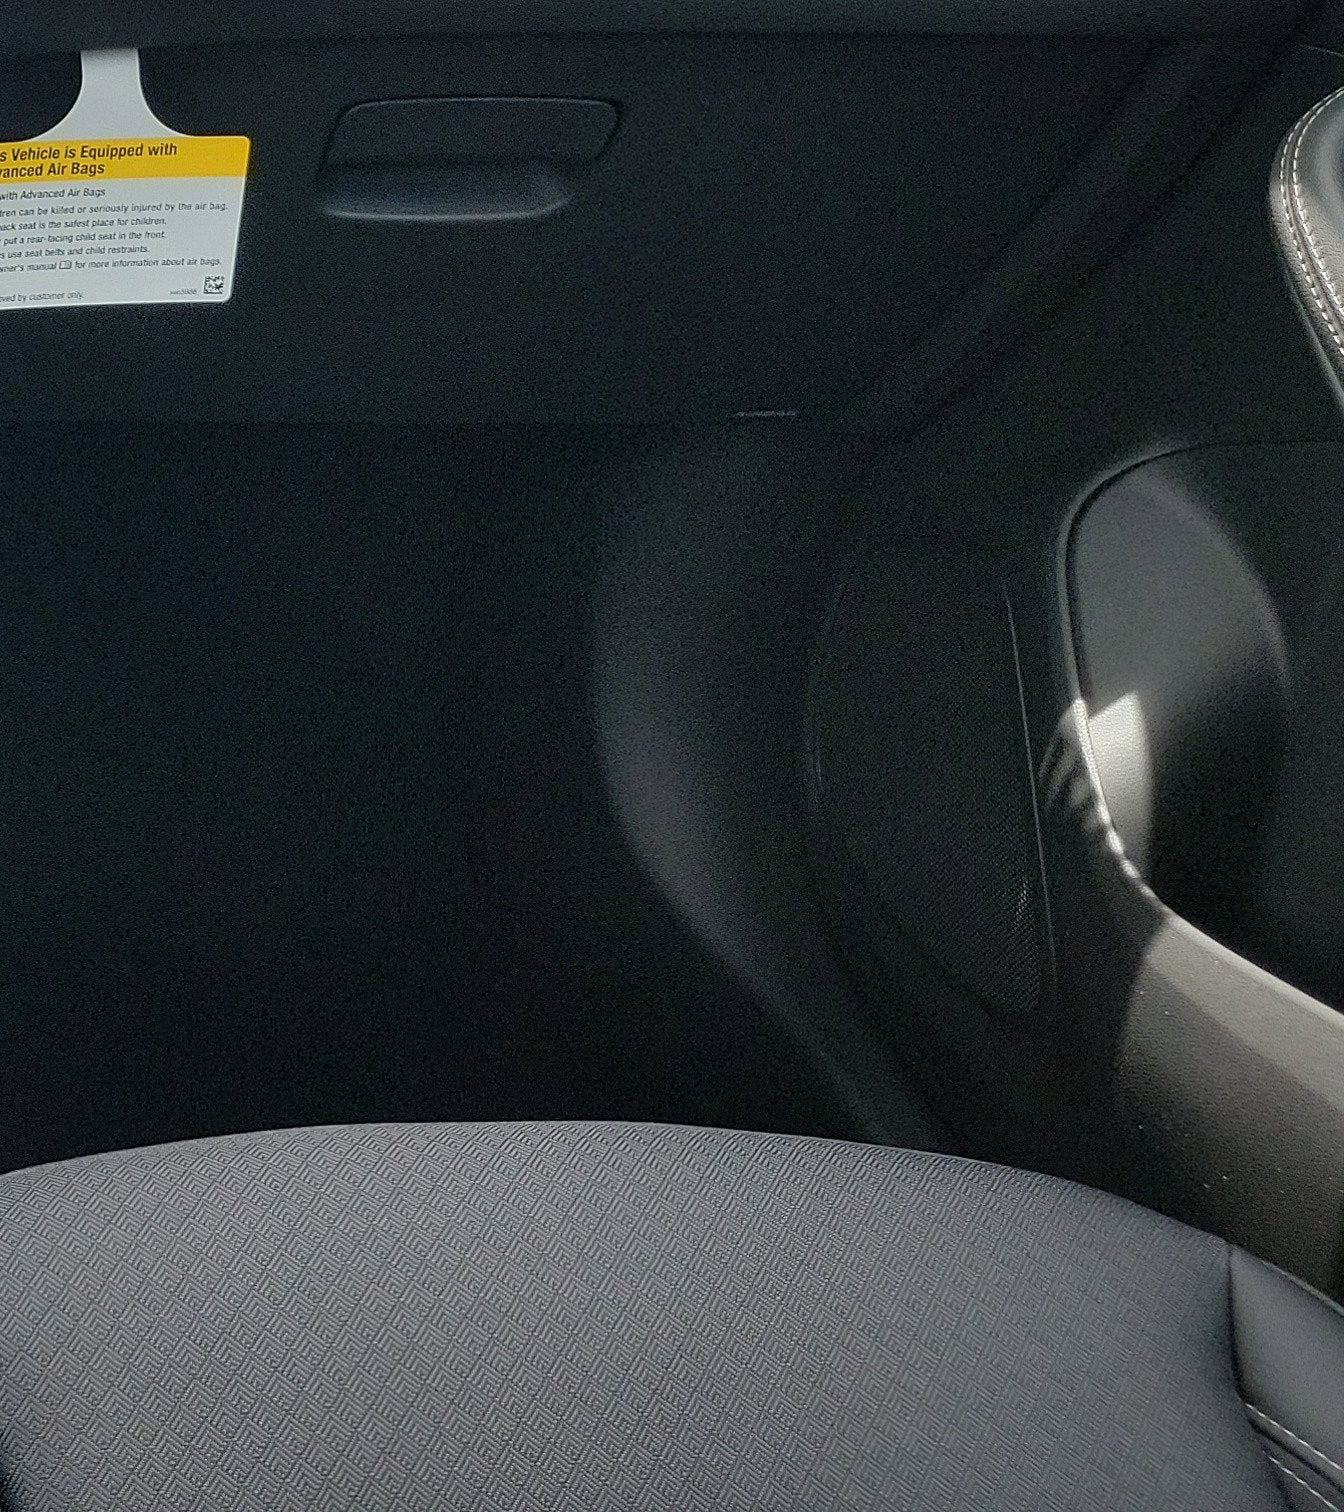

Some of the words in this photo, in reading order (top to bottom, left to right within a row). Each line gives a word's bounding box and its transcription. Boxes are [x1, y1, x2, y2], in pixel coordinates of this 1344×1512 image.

[12, 147, 60, 162] Vehicle
[64, 146, 76, 159] is
[80, 143, 144, 160] Equipped
[148, 143, 178, 157] with
[47, 163, 68, 176] Air
[71, 162, 105, 177] Bags
[0, 191, 18, 201] with
[20, 189, 65, 200] Advanced
[67, 189, 80, 198] Air
[83, 188, 106, 198] Bags
[37, 207, 49, 215] be
[51, 206, 75, 214] killed
[89, 203, 129, 213] seriously
[132, 203, 162, 213] injured
[165, 203, 175, 212] by
[178, 202, 192, 211] the
[195, 202, 207, 210] air
[209, 202, 228, 212] bag.
[18, 222, 37, 230] seat
[39, 221, 46, 229] is
[48, 220, 62, 229] the
[64, 219, 90, 228] safest
[91, 218, 115, 227] place
[117, 218, 129, 226] for
[130, 217, 167, 226] children.
[3, 237, 17, 246] put
[27, 234, 73, 244] rear-facing
[75, 233, 96, 242] child
[98, 232, 116, 241] seat
[128, 231, 142, 240] the
[144, 230, 167, 239] front.
[7, 251, 23, 259] use
[25, 249, 43, 258] seat
[44, 248, 65, 256] belts
[67, 247, 83, 255] and
[85, 246, 106, 255] child
[107, 245, 150, 254] restraints.
[26, 262, 57, 271] manual
[75, 260, 86, 268] for
[112, 258, 159, 267] information
[161, 258, 185, 266] about
[186, 257, 198, 265] air
